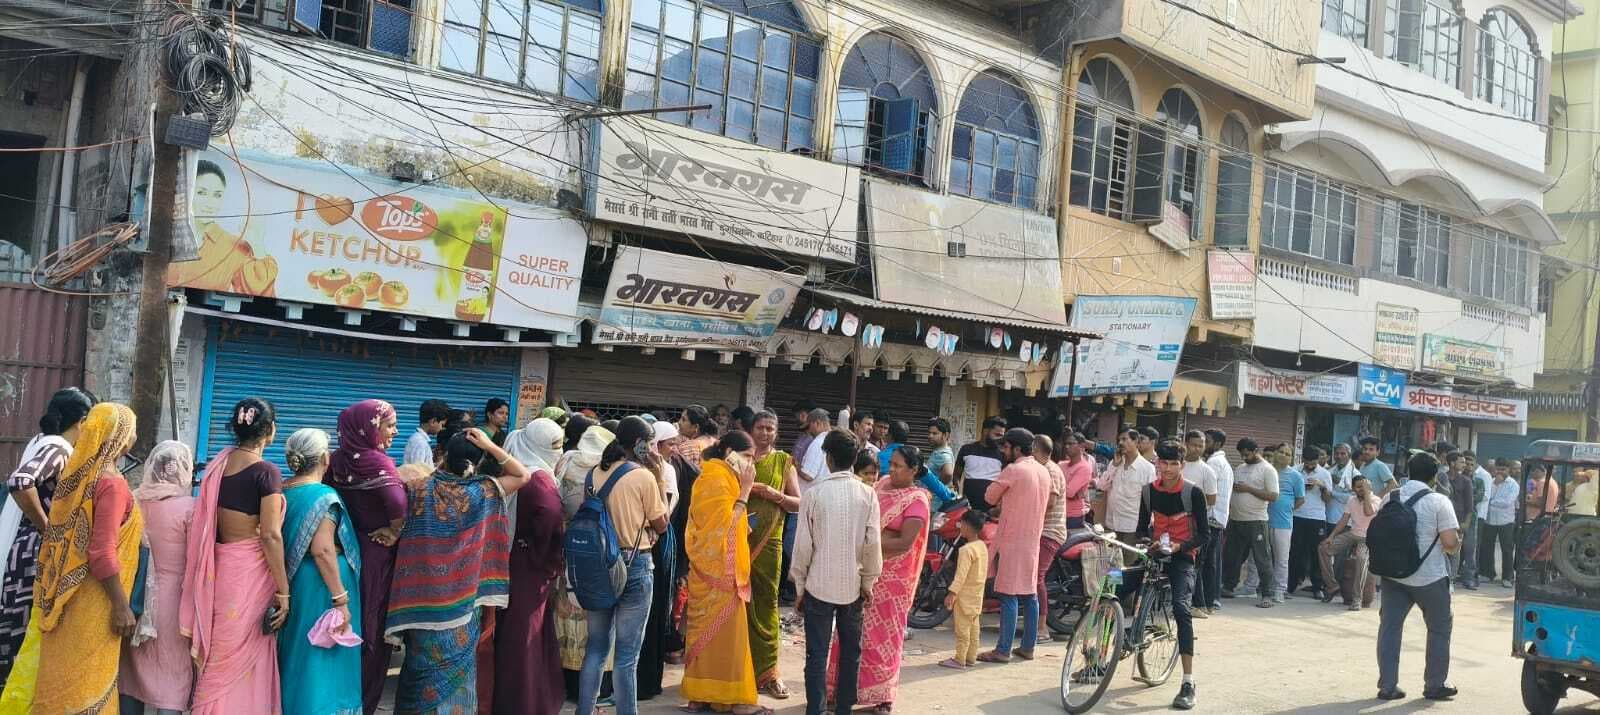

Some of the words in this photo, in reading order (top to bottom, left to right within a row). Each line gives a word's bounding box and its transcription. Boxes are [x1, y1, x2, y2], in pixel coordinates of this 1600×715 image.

[295, 192, 305, 222] I
[375, 200, 424, 229] Tops
[629, 203, 639, 216] श्री
[680, 215, 698, 228] भारत
[289, 227, 422, 267] KETCHUP
[518, 253, 569, 274] SUPER
[508, 271, 573, 292] QUALITY
[1109, 322, 1152, 331] STATIONARY
[1361, 380, 1400, 399] RCM
